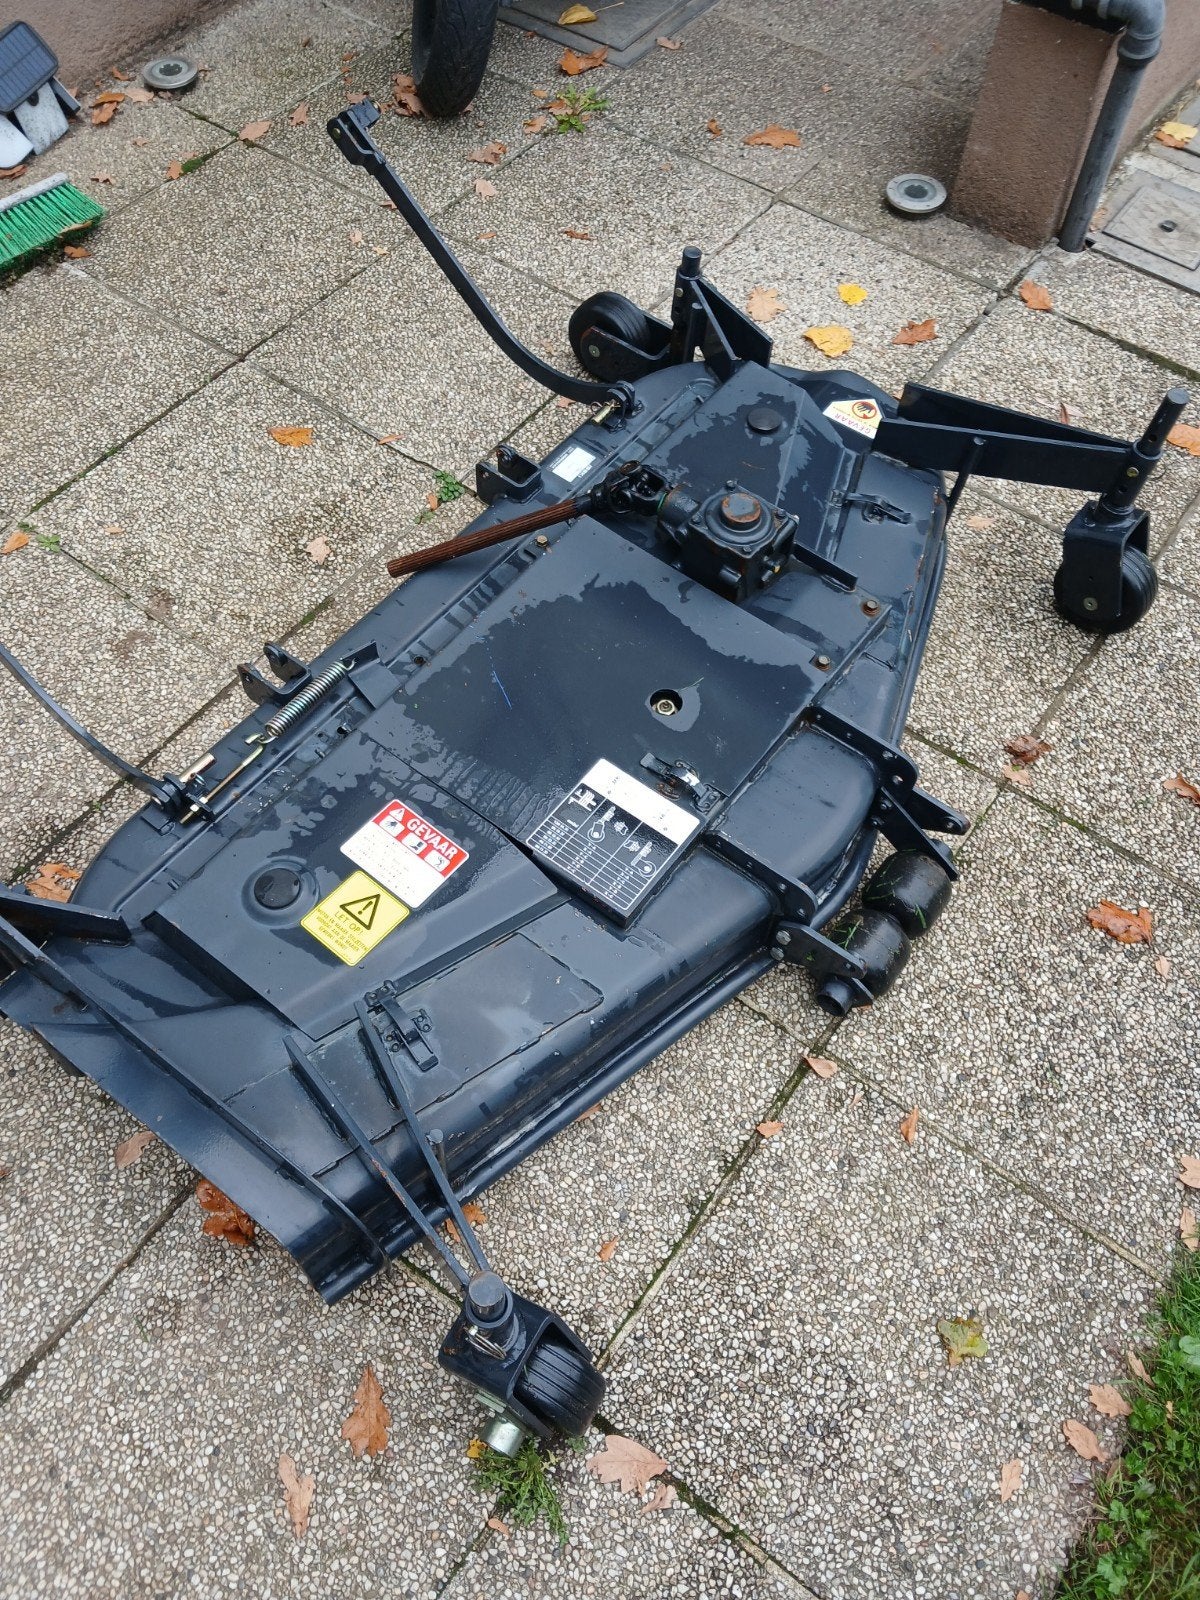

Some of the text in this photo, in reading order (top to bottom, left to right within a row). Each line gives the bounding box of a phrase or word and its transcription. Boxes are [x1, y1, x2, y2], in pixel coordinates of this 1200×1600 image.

[834, 412, 871, 434] GEVAAR
[406, 817, 459, 860] GEVAAR
[334, 911, 364, 935] LET OP!
